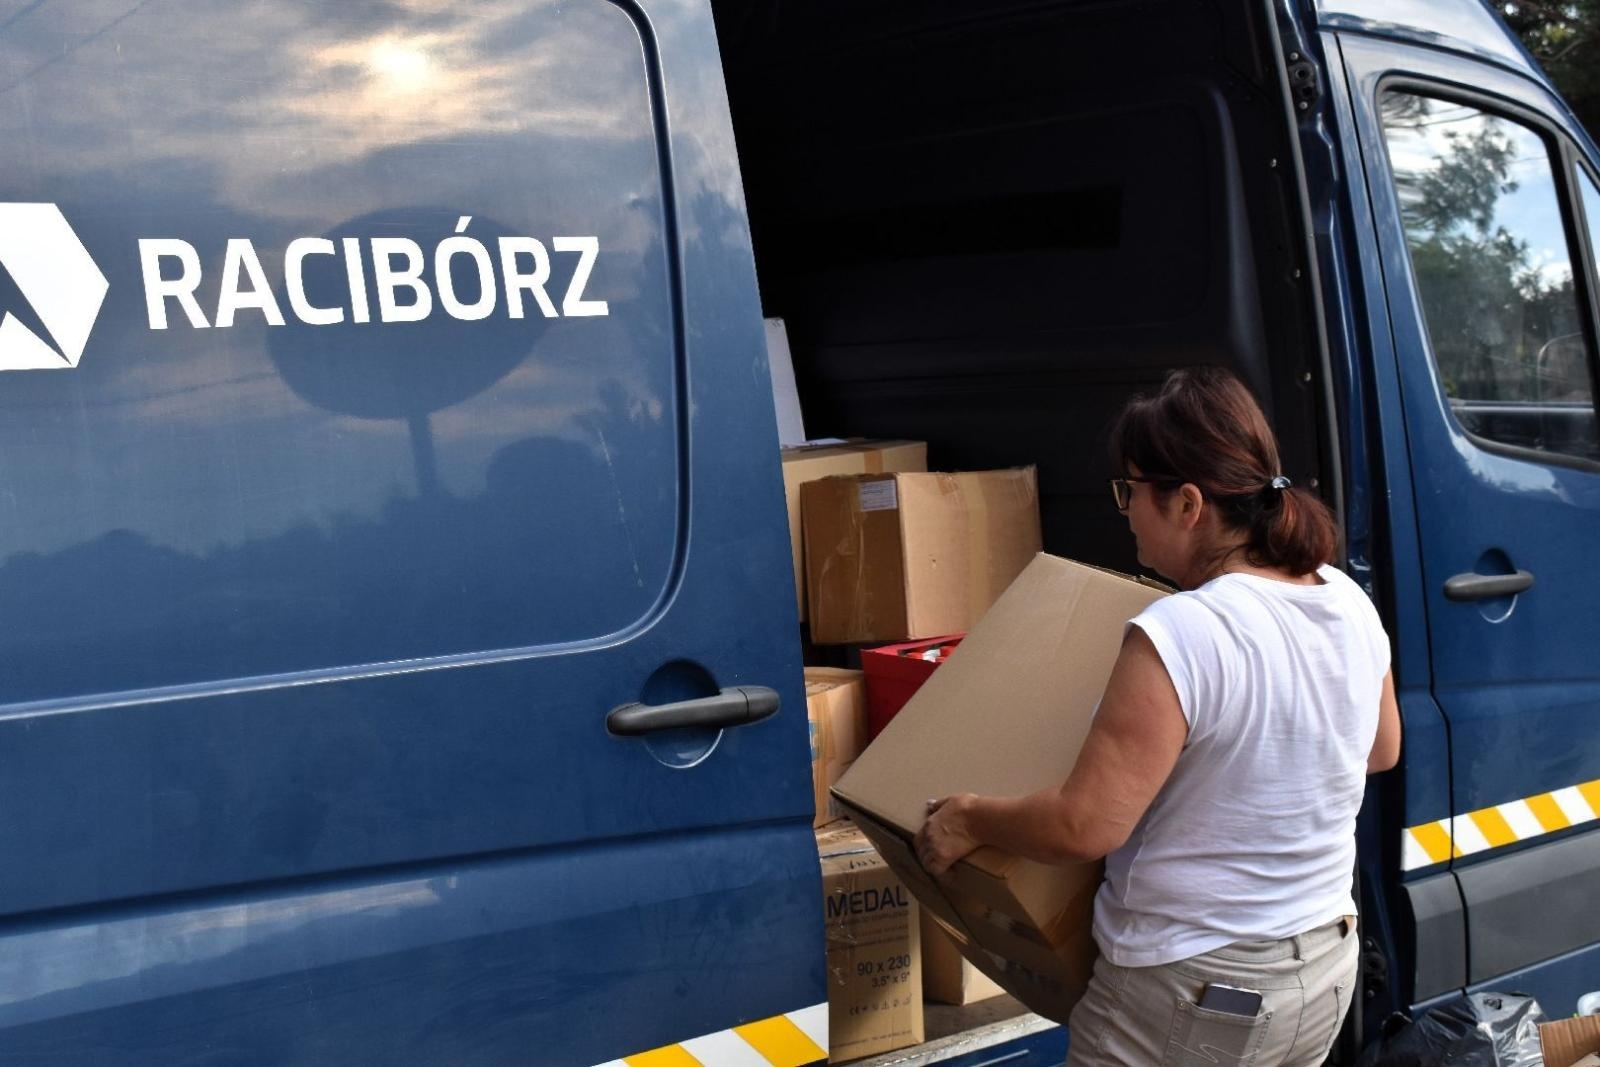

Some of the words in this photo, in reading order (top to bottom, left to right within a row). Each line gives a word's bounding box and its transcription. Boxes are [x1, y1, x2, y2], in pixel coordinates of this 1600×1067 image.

[138, 216, 609, 330] RACIBÓRZ
[827, 885, 909, 918] MEDAL
[857, 961, 873, 976] 90
[877, 963, 884, 972] x
[888, 954, 911, 971] 230
